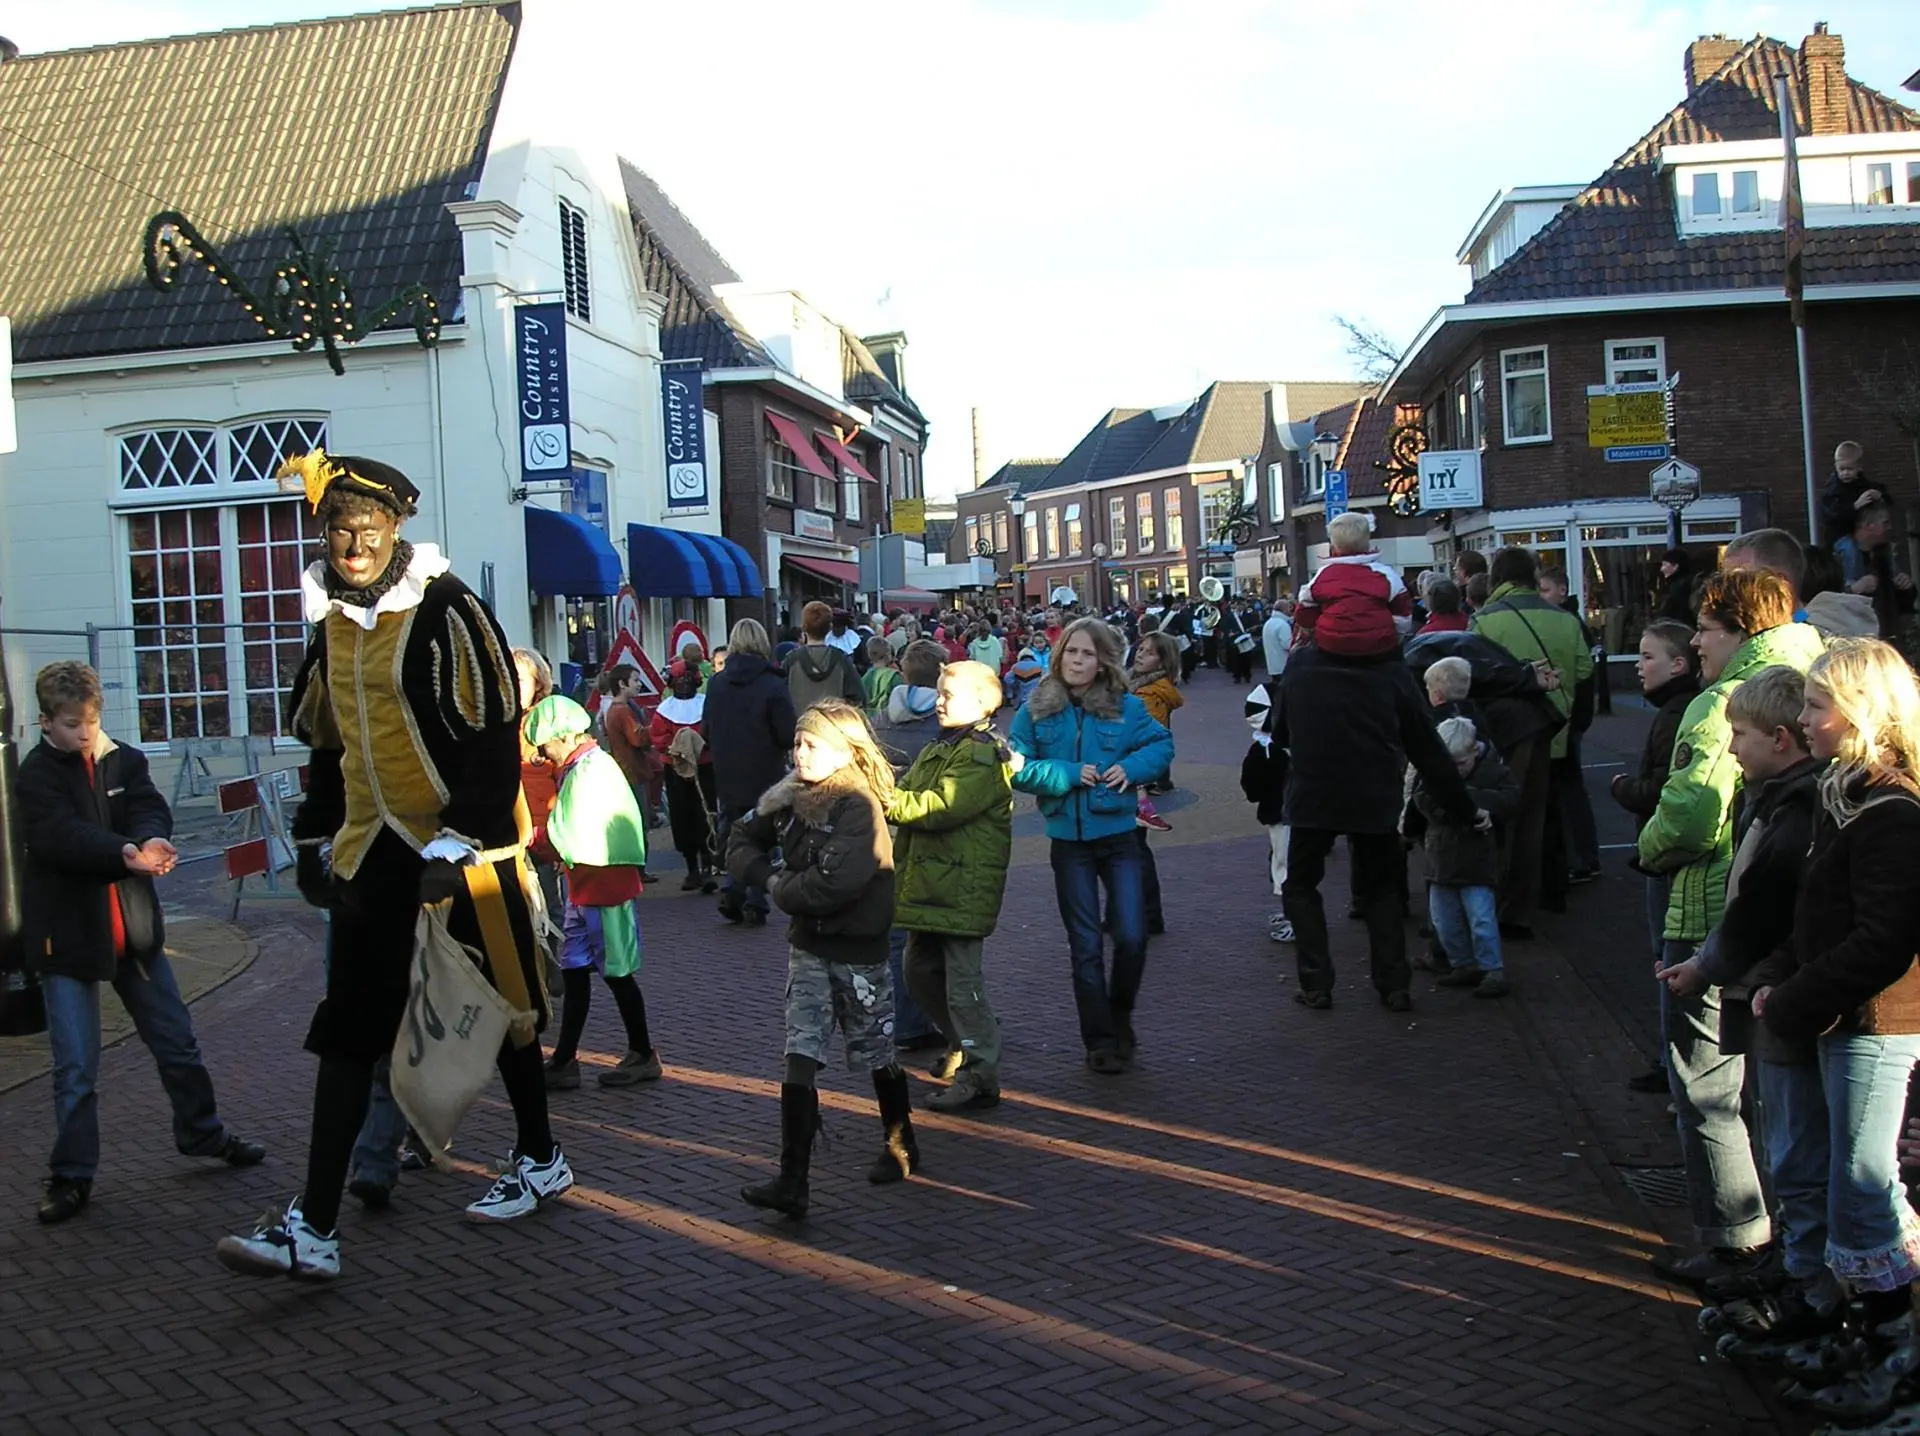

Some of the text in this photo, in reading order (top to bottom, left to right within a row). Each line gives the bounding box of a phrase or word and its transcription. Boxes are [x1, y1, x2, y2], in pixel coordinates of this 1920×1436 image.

[522, 316, 549, 420] Country
[548, 348, 561, 419] wishes
[667, 379, 688, 460] Country
[687, 403, 698, 459] wishes
[1330, 474, 1341, 490] P
[1428, 467, 1459, 490] ITY
